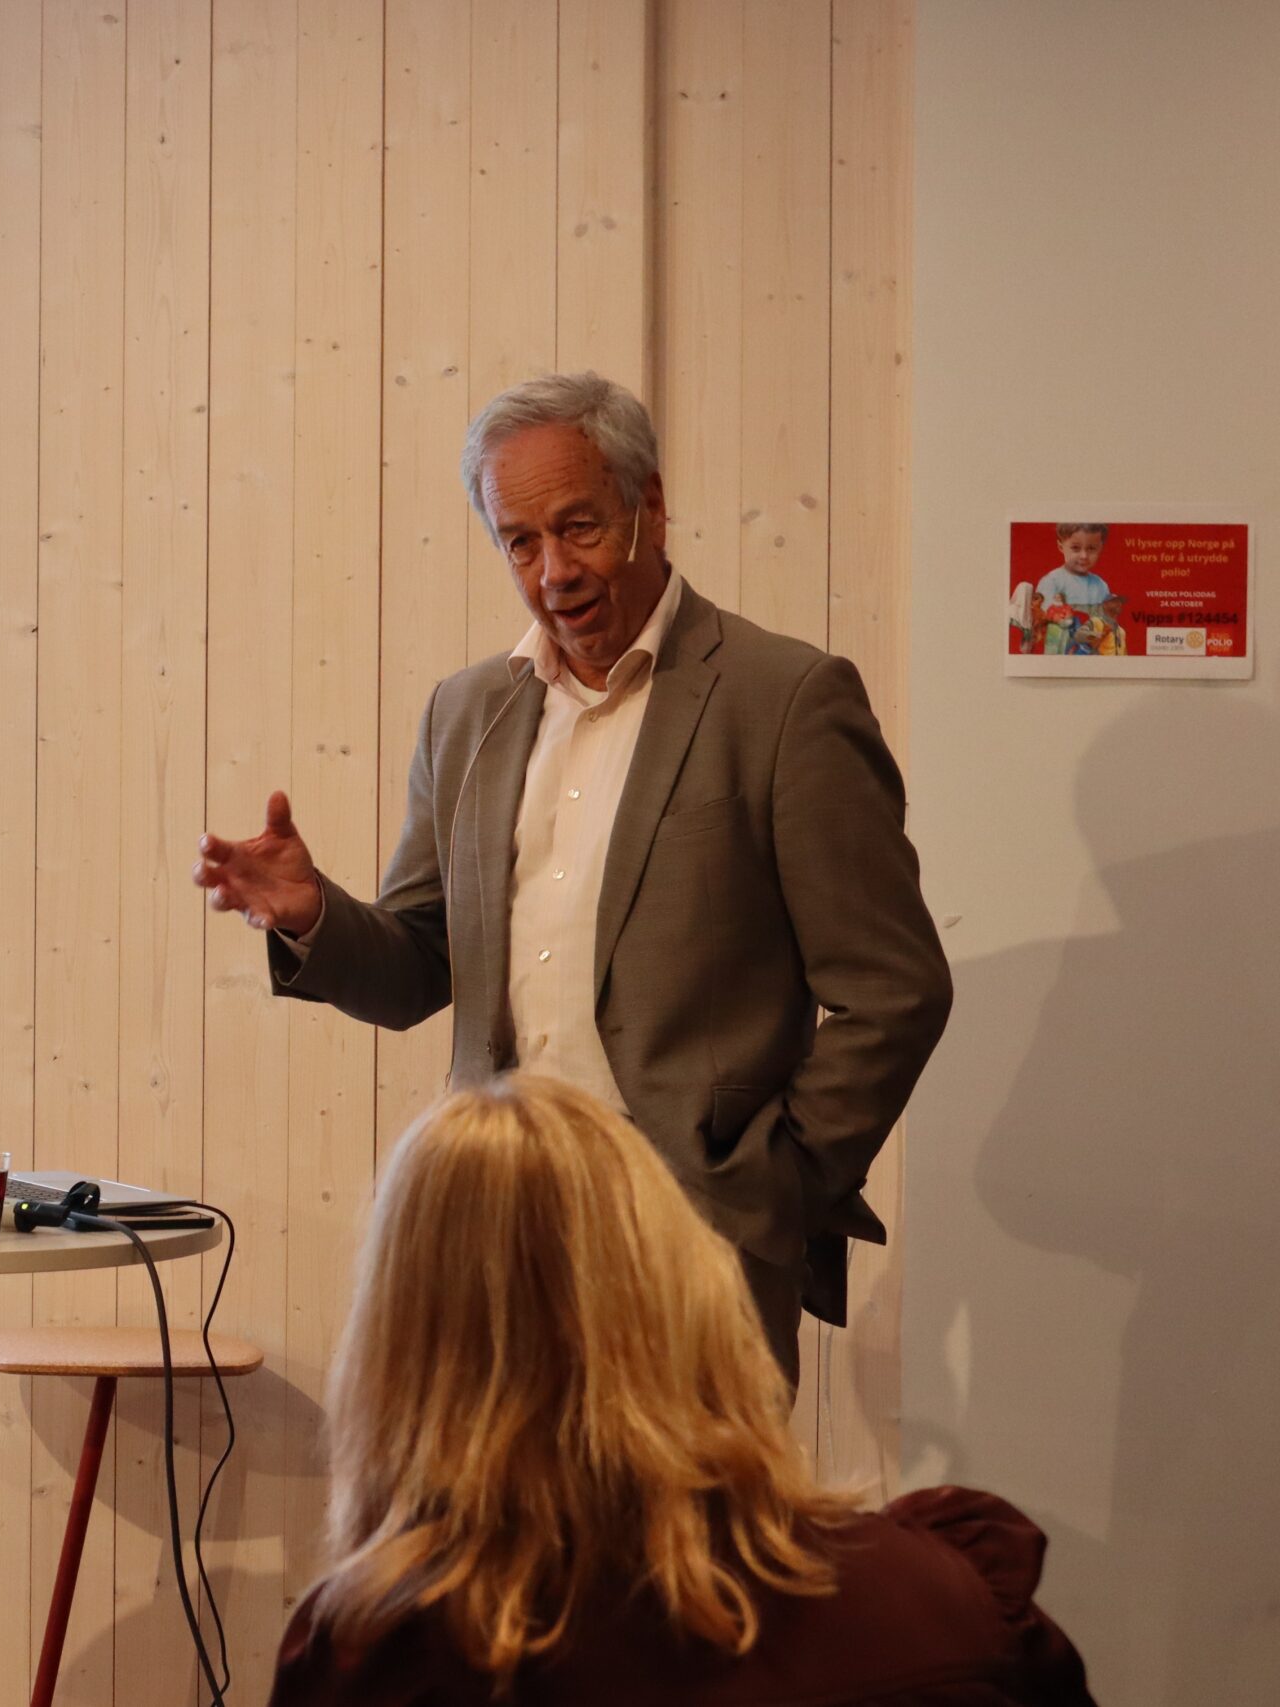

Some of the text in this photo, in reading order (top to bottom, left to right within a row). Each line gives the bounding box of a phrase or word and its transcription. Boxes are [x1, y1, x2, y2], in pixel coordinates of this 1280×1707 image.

[1125, 539, 1135, 547] Vi
[1166, 541, 1185, 549] opp
[1188, 539, 1220, 550] Norge
[1131, 553, 1158, 562] tvers
[1160, 552, 1175, 562] for
[1187, 554, 1229, 564] utrydde
[1155, 634, 1184, 645] Rotary
